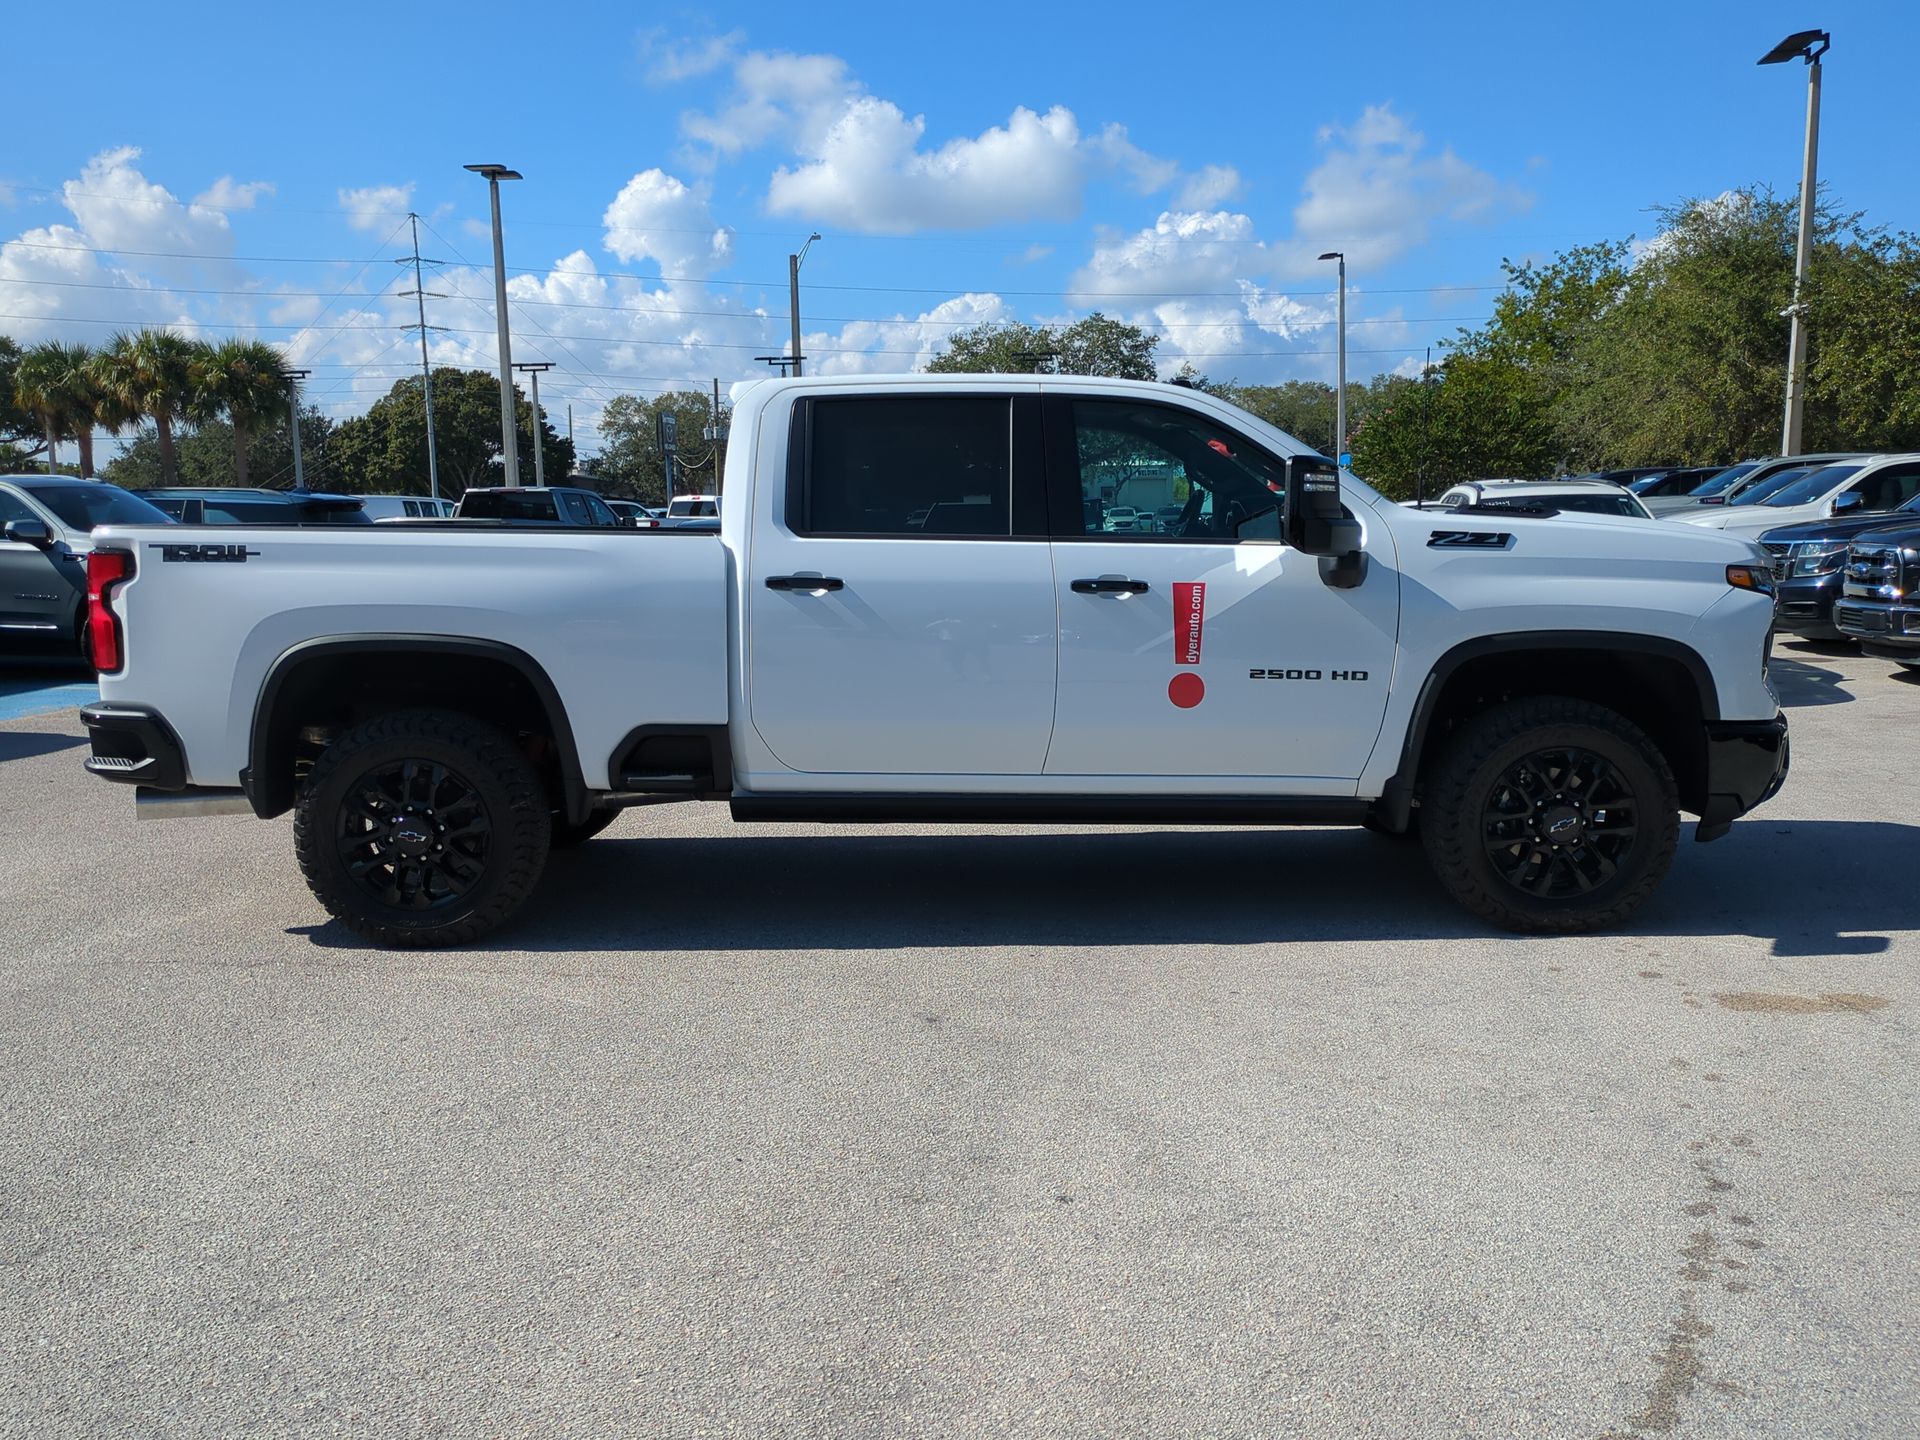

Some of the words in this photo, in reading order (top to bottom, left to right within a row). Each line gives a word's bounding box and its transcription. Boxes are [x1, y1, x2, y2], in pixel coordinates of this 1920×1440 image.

[1186, 585, 1202, 662] dyerauto.com
[1249, 669, 1322, 680] 2500
[1331, 670, 1369, 681] HD
